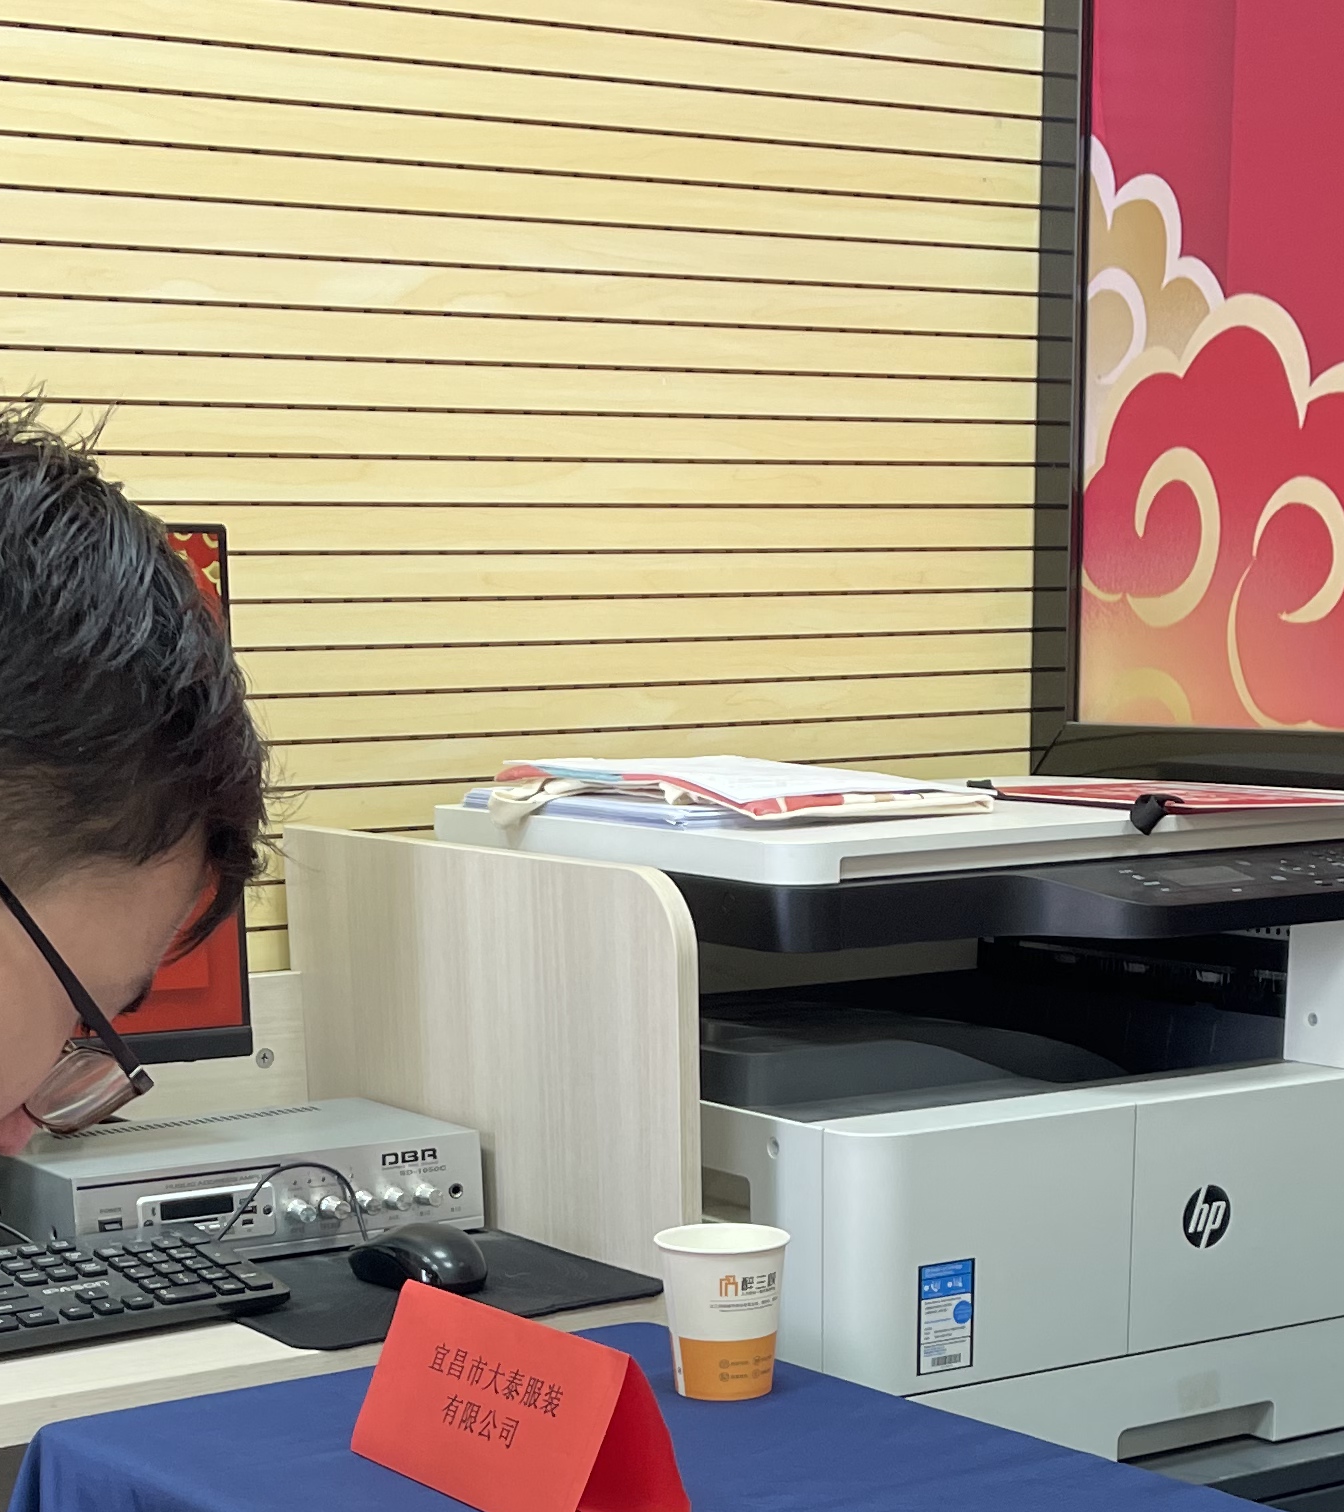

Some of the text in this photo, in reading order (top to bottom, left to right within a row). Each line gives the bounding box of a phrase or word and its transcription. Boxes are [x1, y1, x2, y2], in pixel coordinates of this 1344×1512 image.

[1187, 1185, 1227, 1249] hp
[428, 1342, 564, 1418] 宜昌市大泰服装
[442, 1394, 520, 1449] 有限公司
